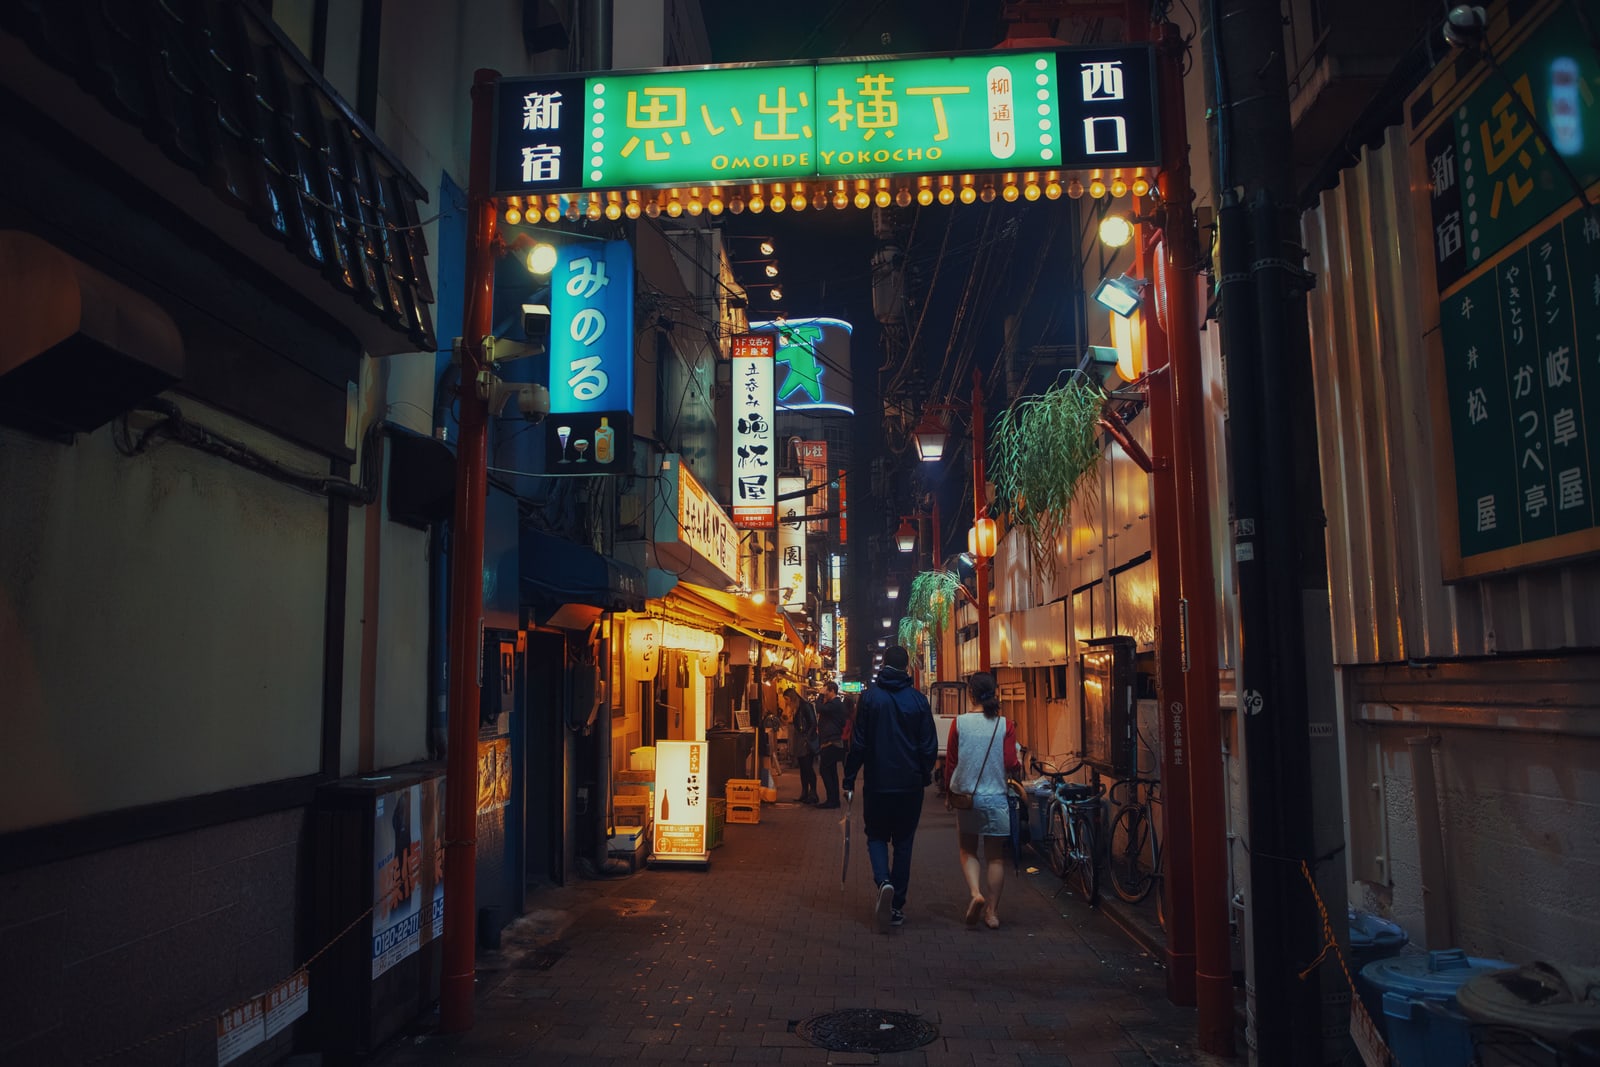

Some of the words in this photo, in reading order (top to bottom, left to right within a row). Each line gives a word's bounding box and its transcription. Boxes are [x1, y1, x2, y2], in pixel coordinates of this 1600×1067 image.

[521, 91, 562, 183] 新宿
[620, 74, 969, 161] 思い出横丁
[989, 77, 1010, 151] 柳通り
[1081, 60, 1129, 154] 西口
[1432, 145, 1463, 263] 新宿
[565, 256, 610, 401] みのる
[1506, 265, 1524, 345] やきとり
[1540, 243, 1562, 325] ラーメン
[735, 348, 746, 356] 2F
[1461, 296, 1479, 370] 牛丼
[1467, 390, 1497, 533] 松屋
[1546, 345, 1584, 511] 岐阜屋
